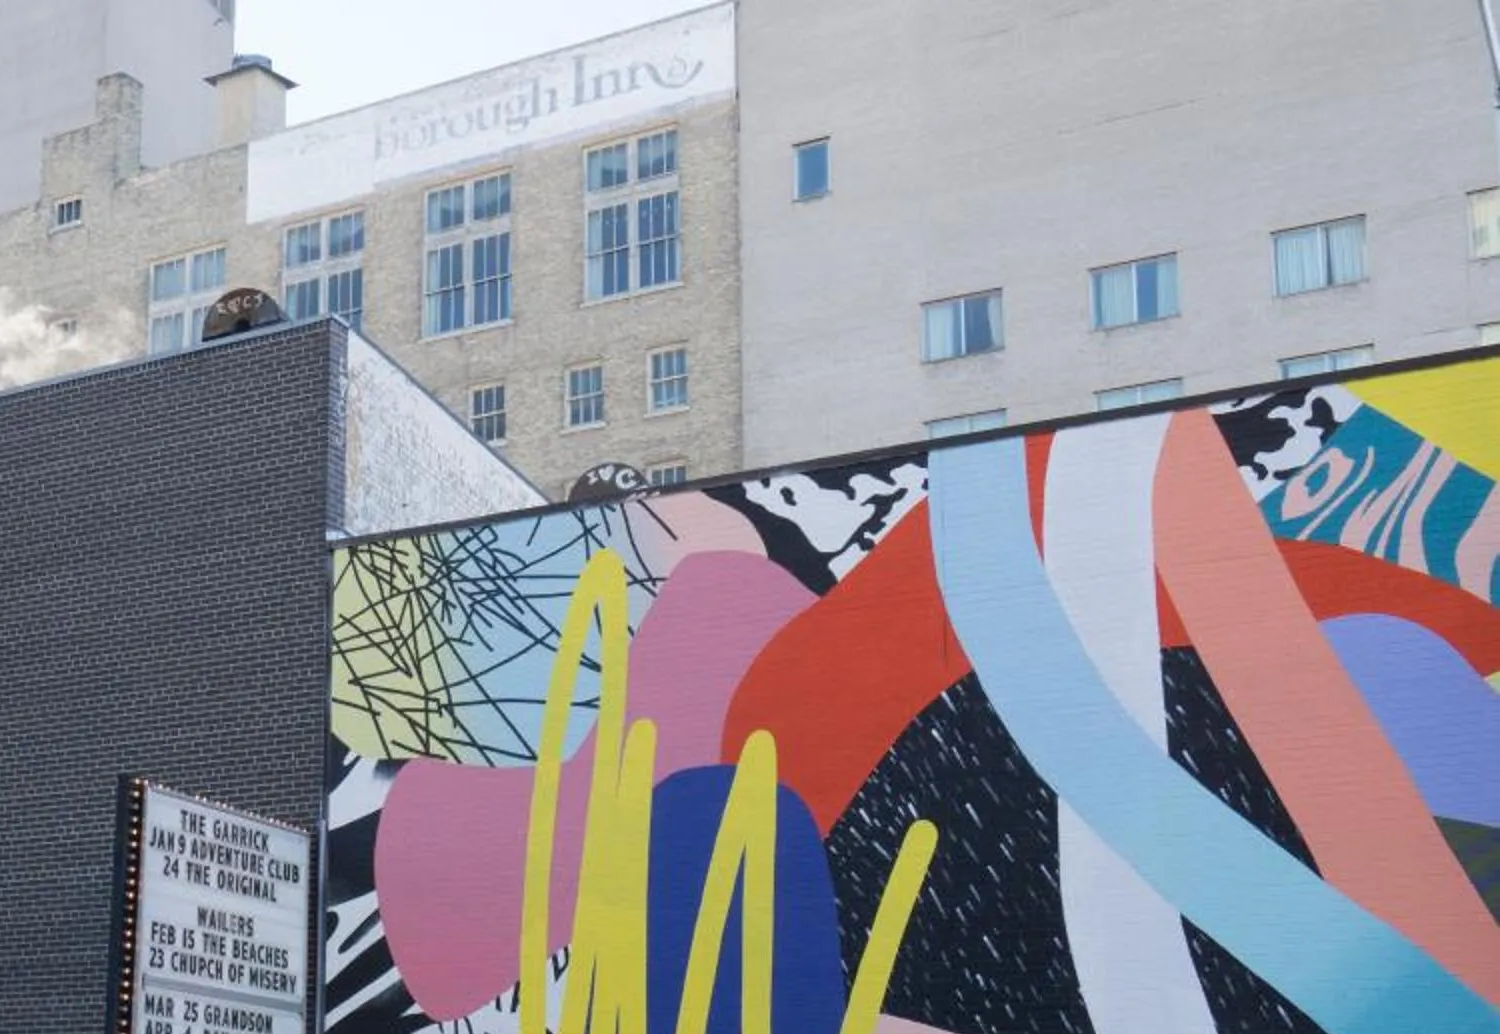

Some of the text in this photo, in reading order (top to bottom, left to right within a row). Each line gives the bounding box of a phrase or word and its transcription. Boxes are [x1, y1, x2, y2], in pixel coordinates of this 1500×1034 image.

[180, 809, 270, 853] THE GARRICK
[149, 826, 300, 884] JAN 9 ADVENTURE CLUB
[163, 855, 277, 902] 24 THE ORIGINAL
[151, 921, 290, 969] FEB 15 THE BEACHES
[197, 906, 255, 938] WAILERS
[149, 947, 165, 969] 23
[228, 963, 245, 984] OF
[249, 967, 297, 994] MISERY
[145, 993, 273, 1034] MAR 25 GRANDSON
